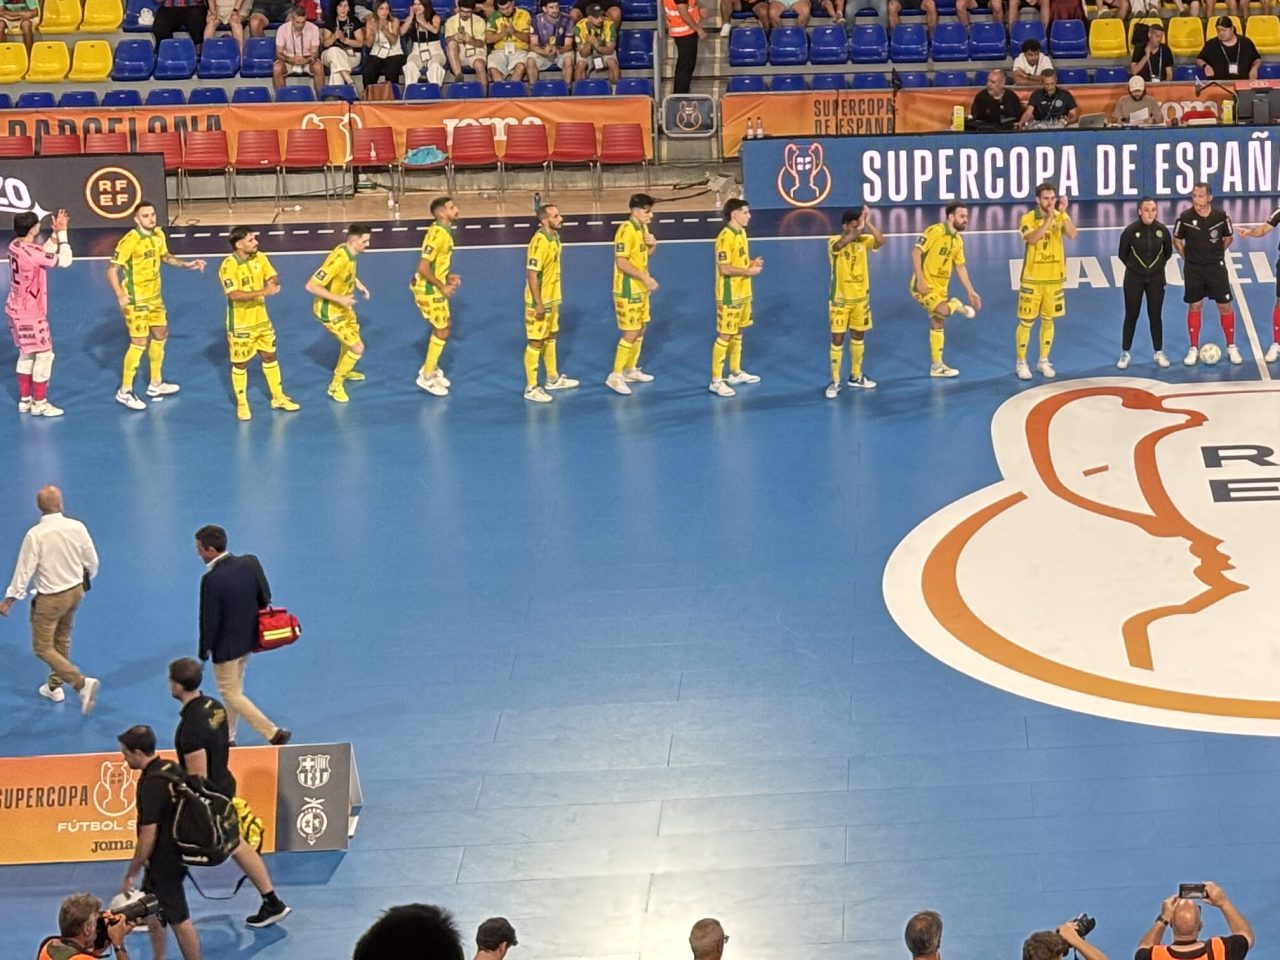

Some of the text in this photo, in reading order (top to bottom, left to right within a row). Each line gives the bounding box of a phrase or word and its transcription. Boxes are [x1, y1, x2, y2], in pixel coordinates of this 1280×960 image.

[814, 98, 894, 117] SUPERCOPA
[862, 145, 1079, 203] SUPERCOPA
[1097, 143, 1138, 196] DE
[0, 785, 88, 809] UPERCOPA
[57, 819, 138, 832] FÚTBOL S
